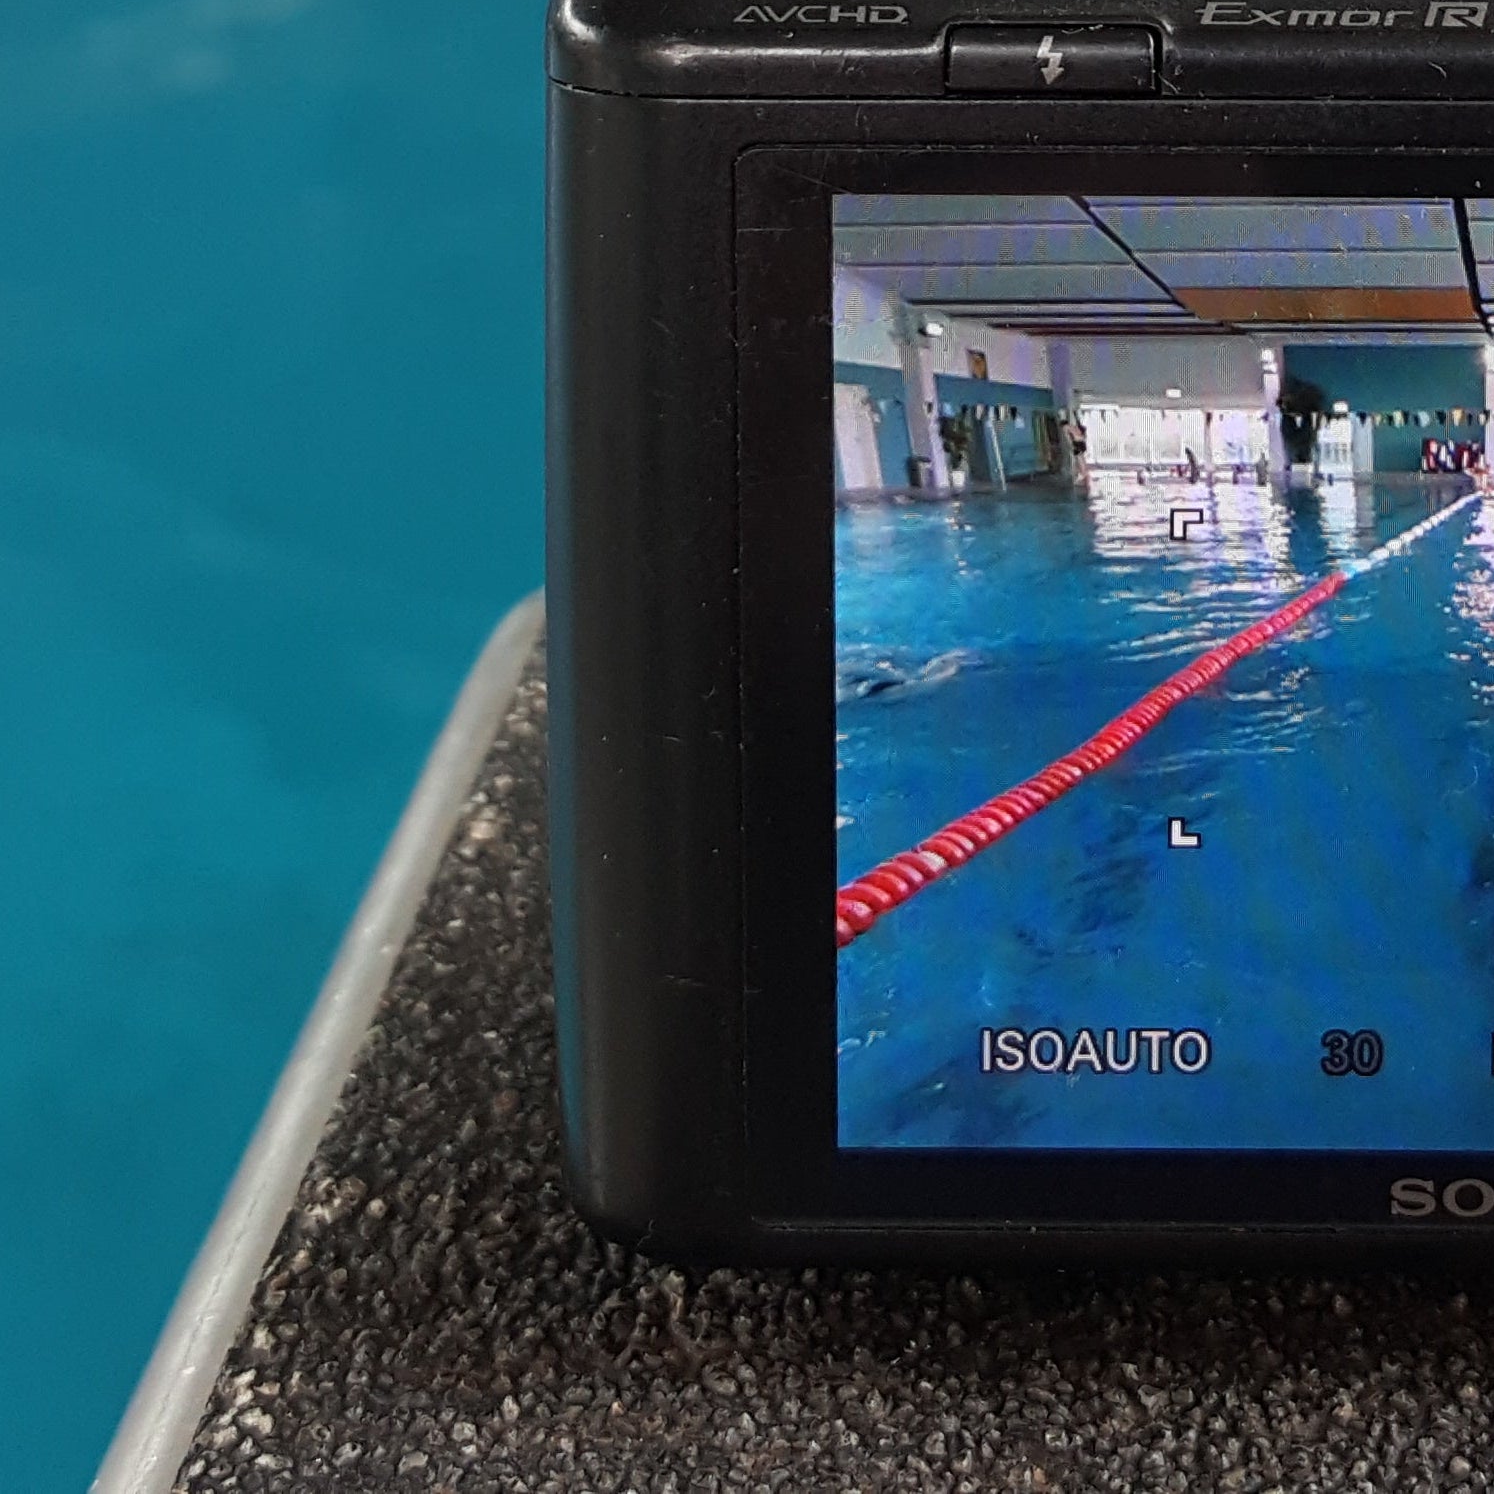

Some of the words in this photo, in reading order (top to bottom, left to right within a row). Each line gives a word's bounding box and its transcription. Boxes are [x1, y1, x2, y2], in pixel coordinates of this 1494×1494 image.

[733, 5, 909, 24] AVCHD
[1195, 1, 1414, 26] Exmor
[1424, 1, 1490, 27] R
[981, 1029, 1210, 1073] ISOAUTO
[1322, 1030, 1383, 1075] 30
